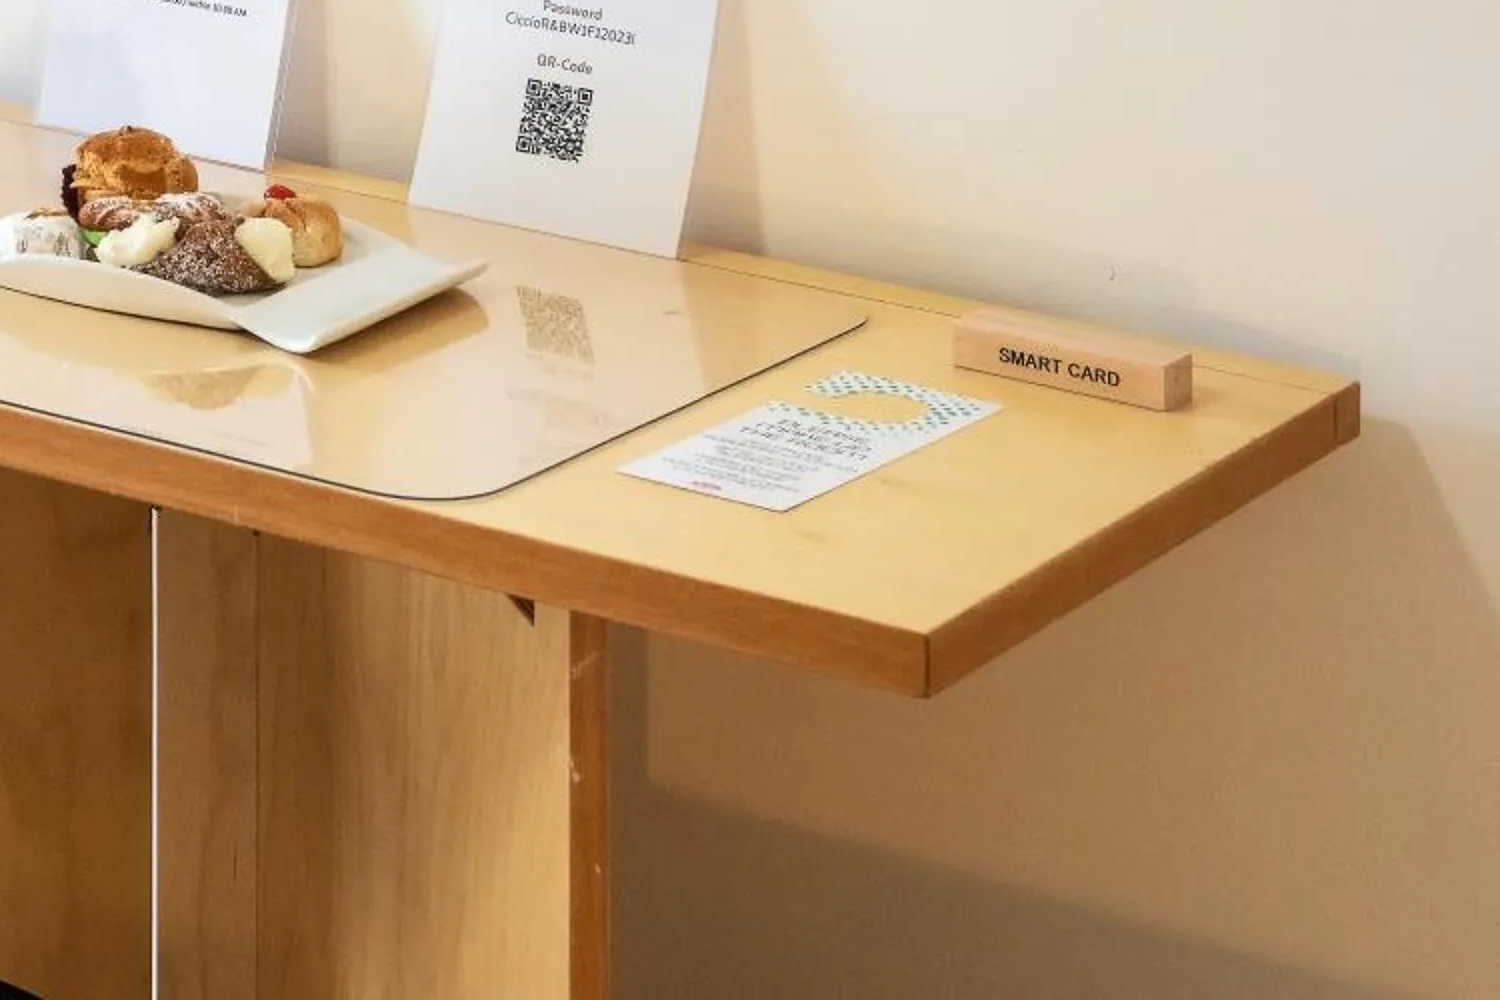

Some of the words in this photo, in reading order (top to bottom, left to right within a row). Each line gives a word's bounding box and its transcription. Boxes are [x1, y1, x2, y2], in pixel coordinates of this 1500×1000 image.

[543, 0, 603, 21] Password
[537, 53, 593, 75] QR-Code
[998, 347, 1063, 375] SMART
[1067, 362, 1121, 388] CARD
